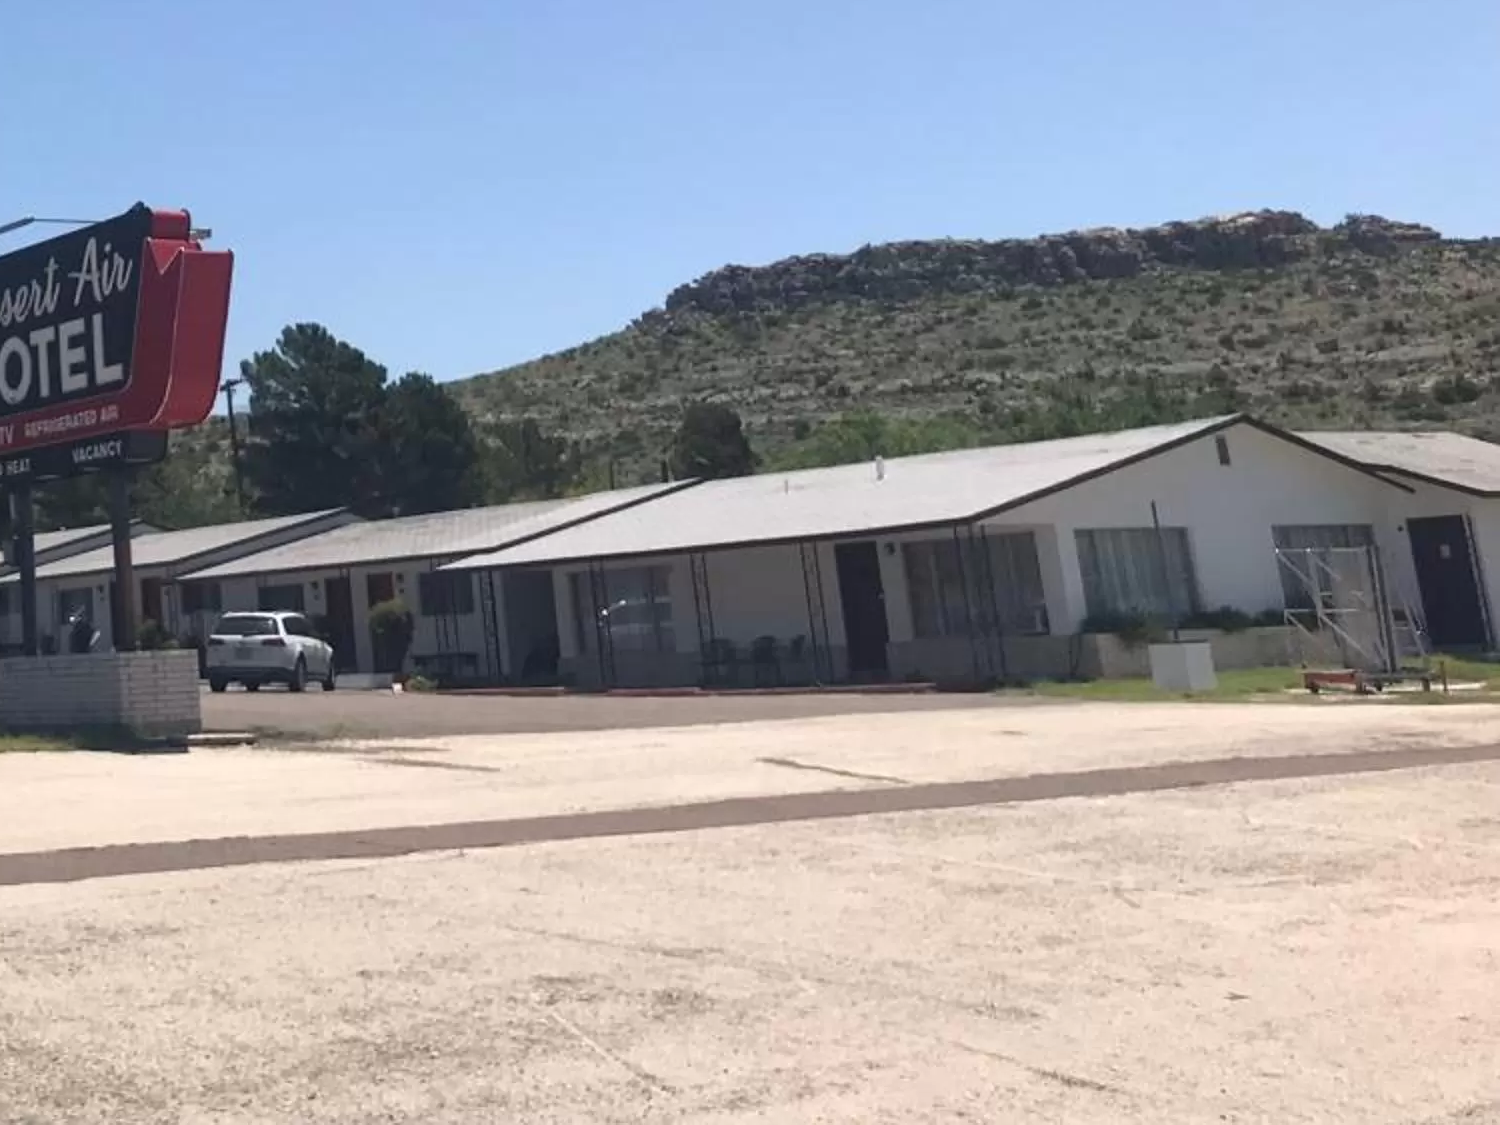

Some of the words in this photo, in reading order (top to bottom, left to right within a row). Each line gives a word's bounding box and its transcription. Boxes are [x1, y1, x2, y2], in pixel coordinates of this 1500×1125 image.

[67, 236, 133, 307] Air
[0, 425, 15, 444] TV
[100, 404, 119, 422] AIR
[6, 458, 31, 475] HEAT
[72, 440, 123, 463] VACANCY
